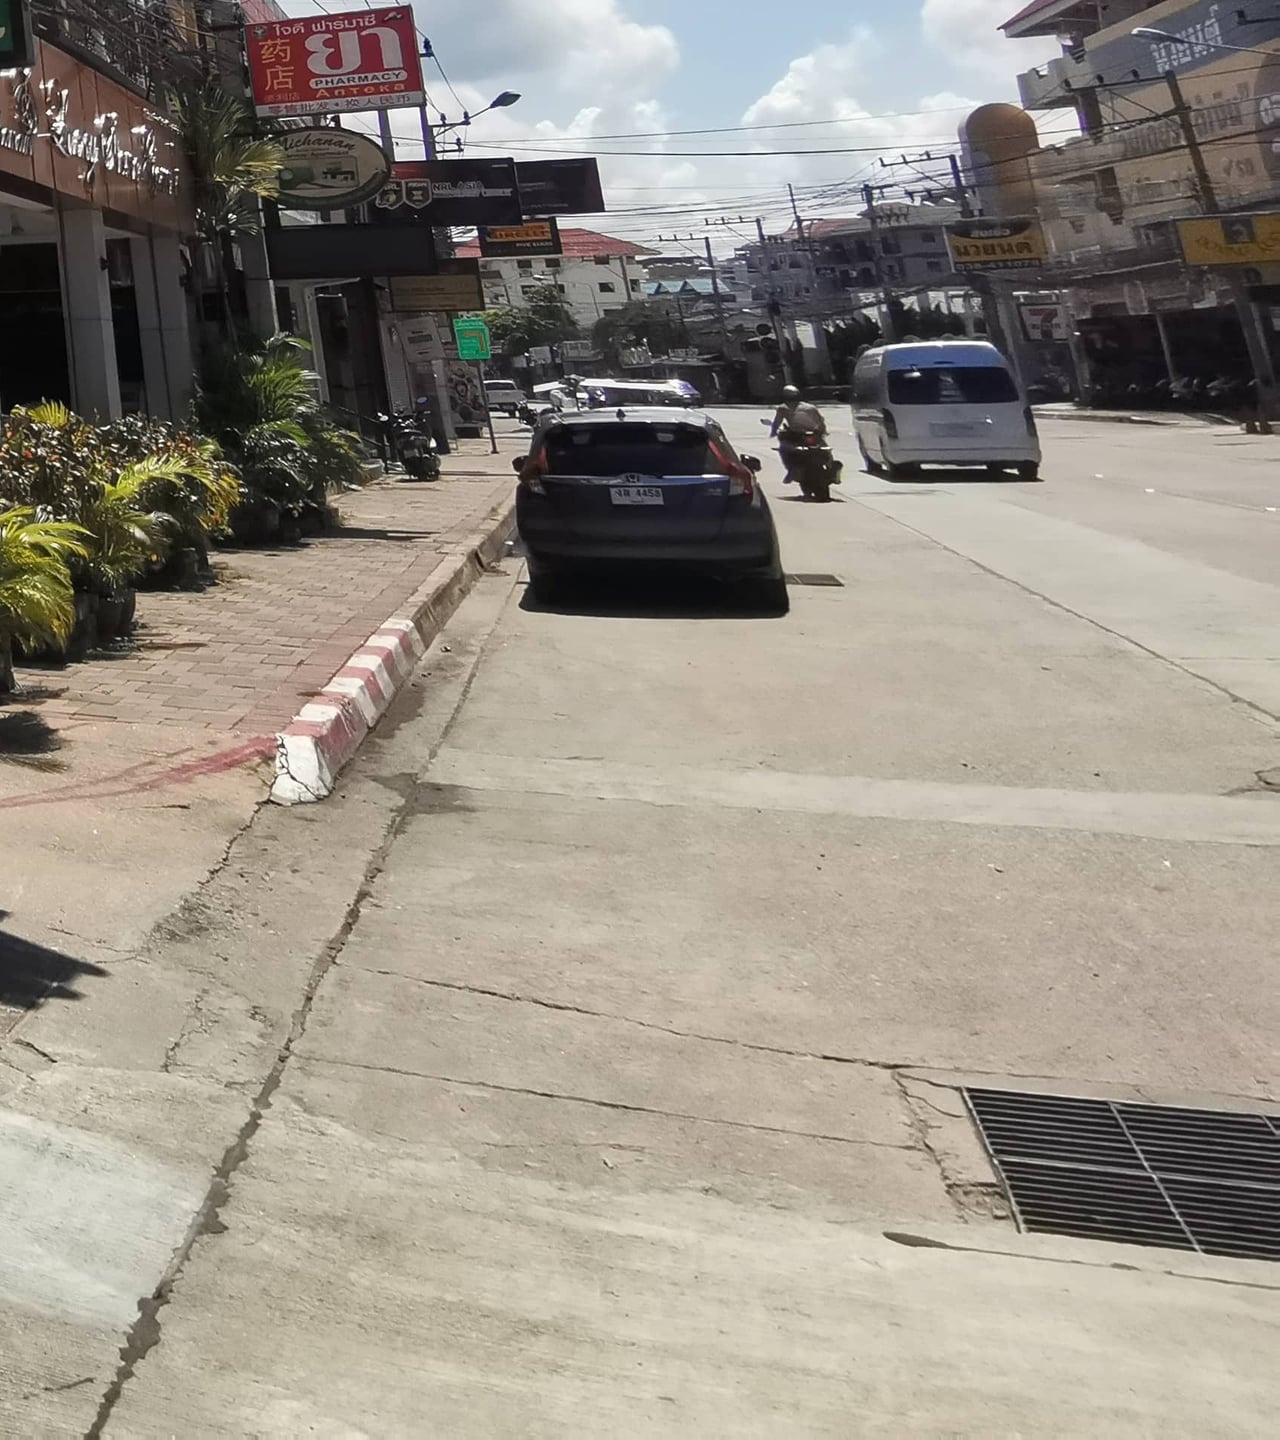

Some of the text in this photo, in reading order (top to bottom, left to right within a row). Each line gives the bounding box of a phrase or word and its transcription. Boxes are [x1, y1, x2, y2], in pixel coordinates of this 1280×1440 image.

[273, 22, 305, 36] ใจดี
[258, 39, 295, 92] 药店
[304, 26, 404, 76] ยา
[314, 71, 403, 88] PHARMACY
